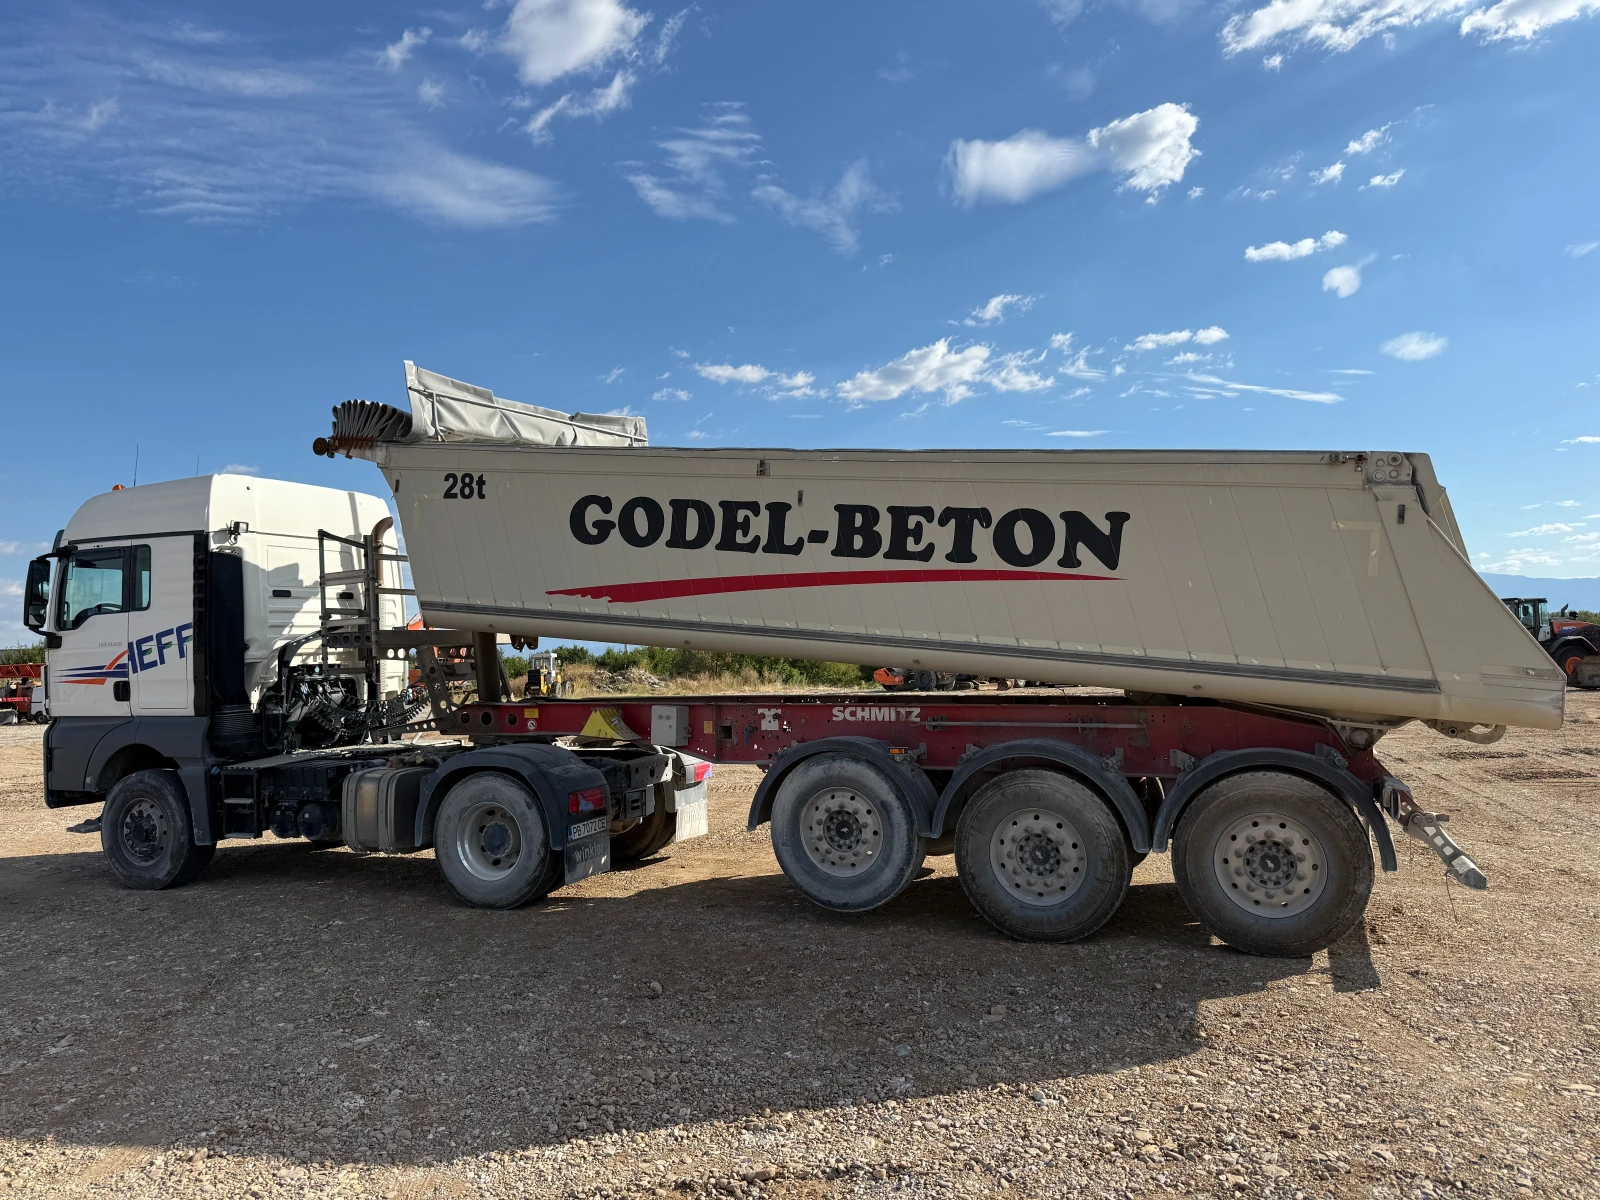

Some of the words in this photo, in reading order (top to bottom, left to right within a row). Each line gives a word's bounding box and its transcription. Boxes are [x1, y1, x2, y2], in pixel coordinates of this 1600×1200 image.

[443, 472, 486, 499] 28t
[569, 494, 1131, 571] GODEL-BETON
[831, 706, 921, 722] SCHMITZ
